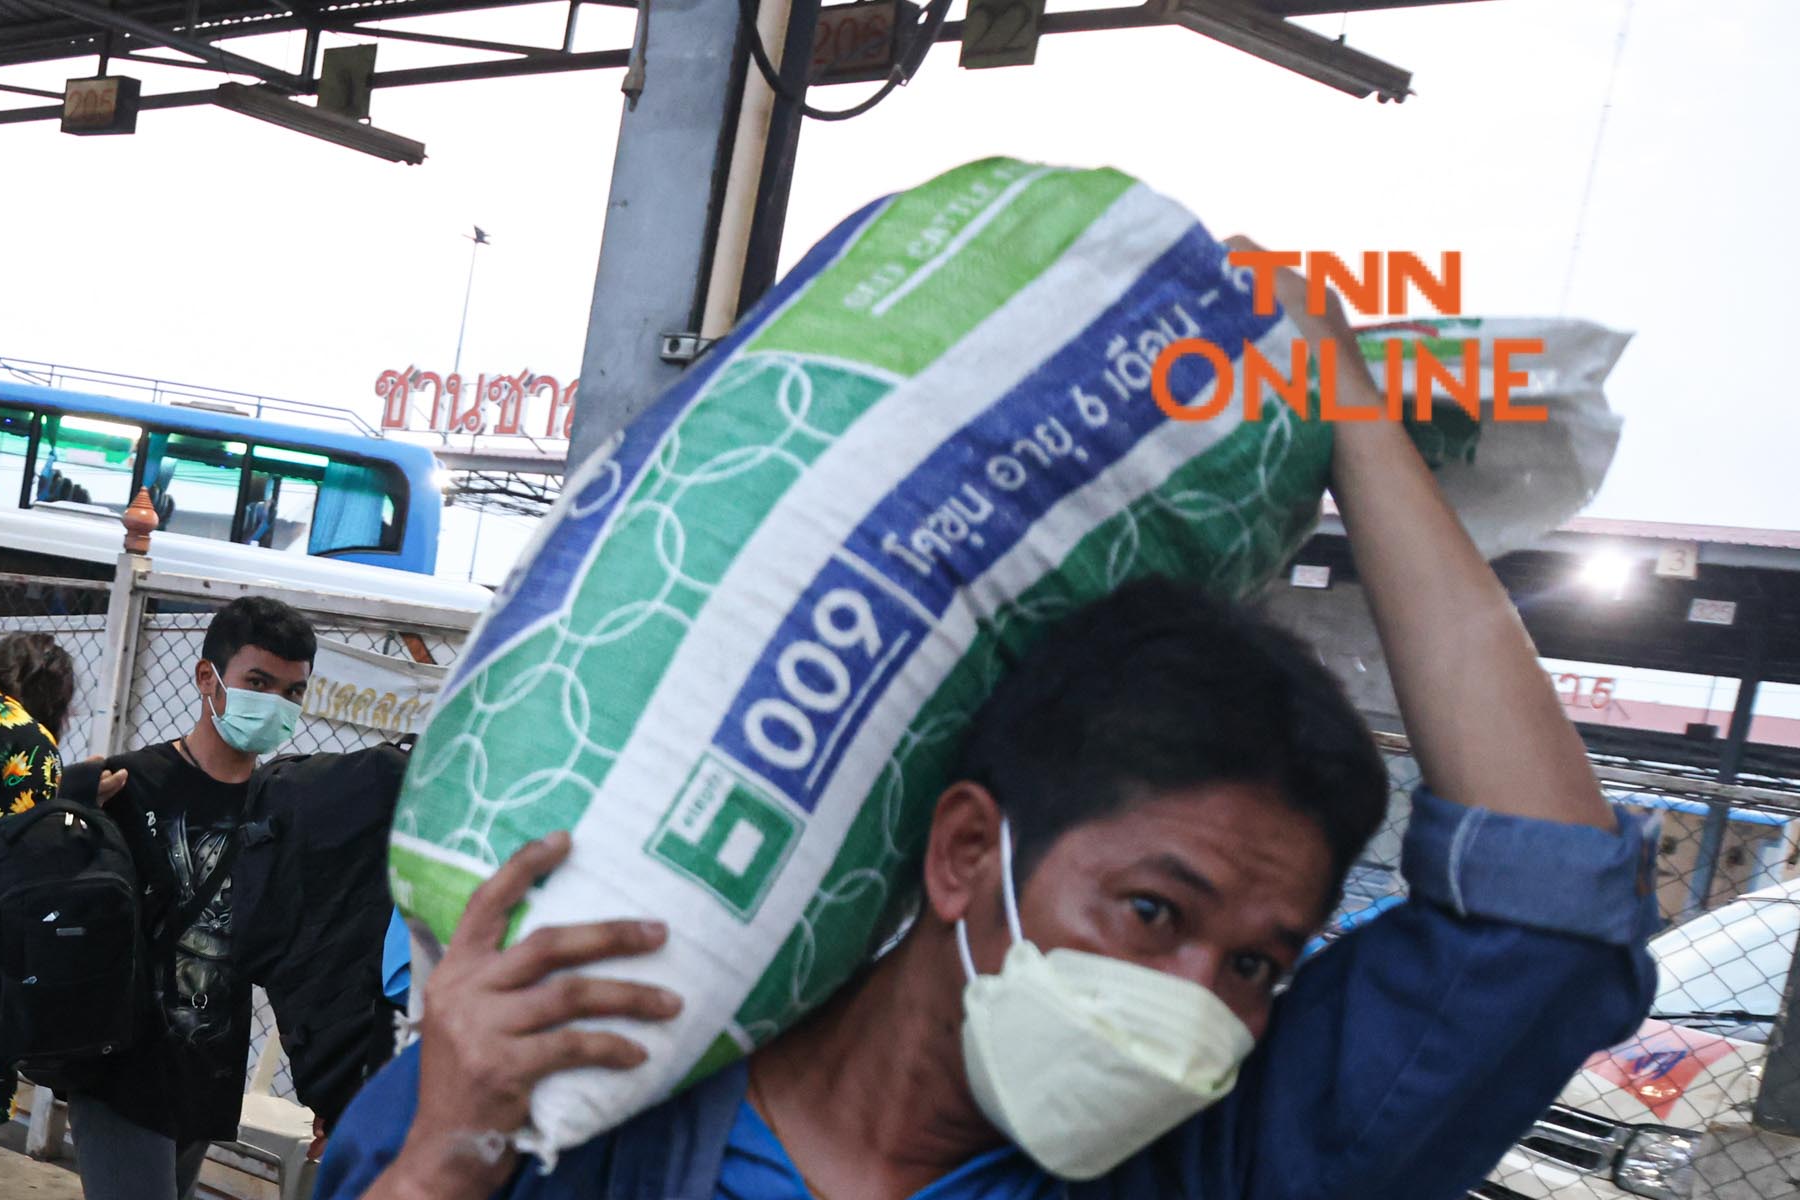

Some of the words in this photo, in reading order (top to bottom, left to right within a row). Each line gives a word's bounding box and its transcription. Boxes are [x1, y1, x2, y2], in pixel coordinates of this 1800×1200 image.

[881, 482, 995, 577] โคขุน
[985, 415, 1089, 491] อายุ
[1070, 383, 1109, 429] 6
[744, 588, 884, 770] 009
